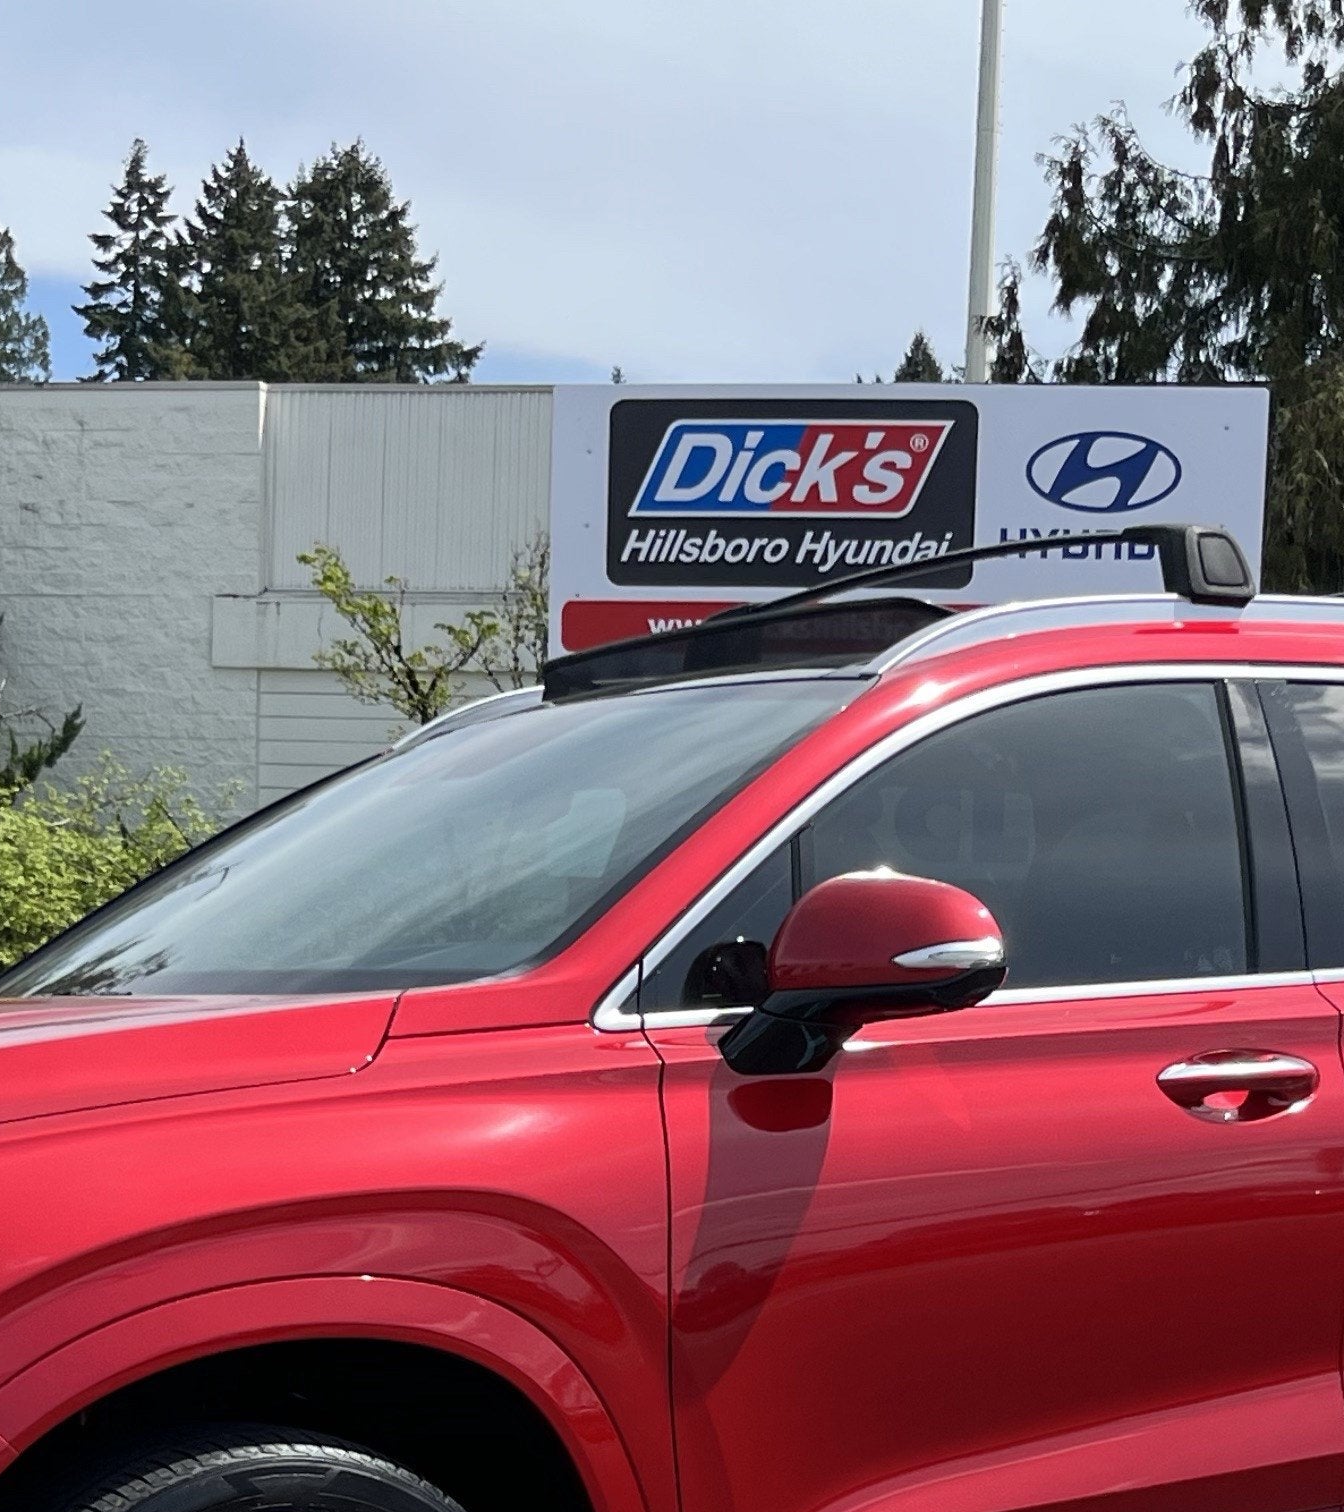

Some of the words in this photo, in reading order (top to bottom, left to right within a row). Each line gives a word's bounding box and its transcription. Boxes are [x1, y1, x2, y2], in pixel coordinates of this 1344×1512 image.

[653, 428, 913, 505] Dick's
[619, 528, 789, 564] Hillsboro
[794, 529, 954, 573] Hyundai
